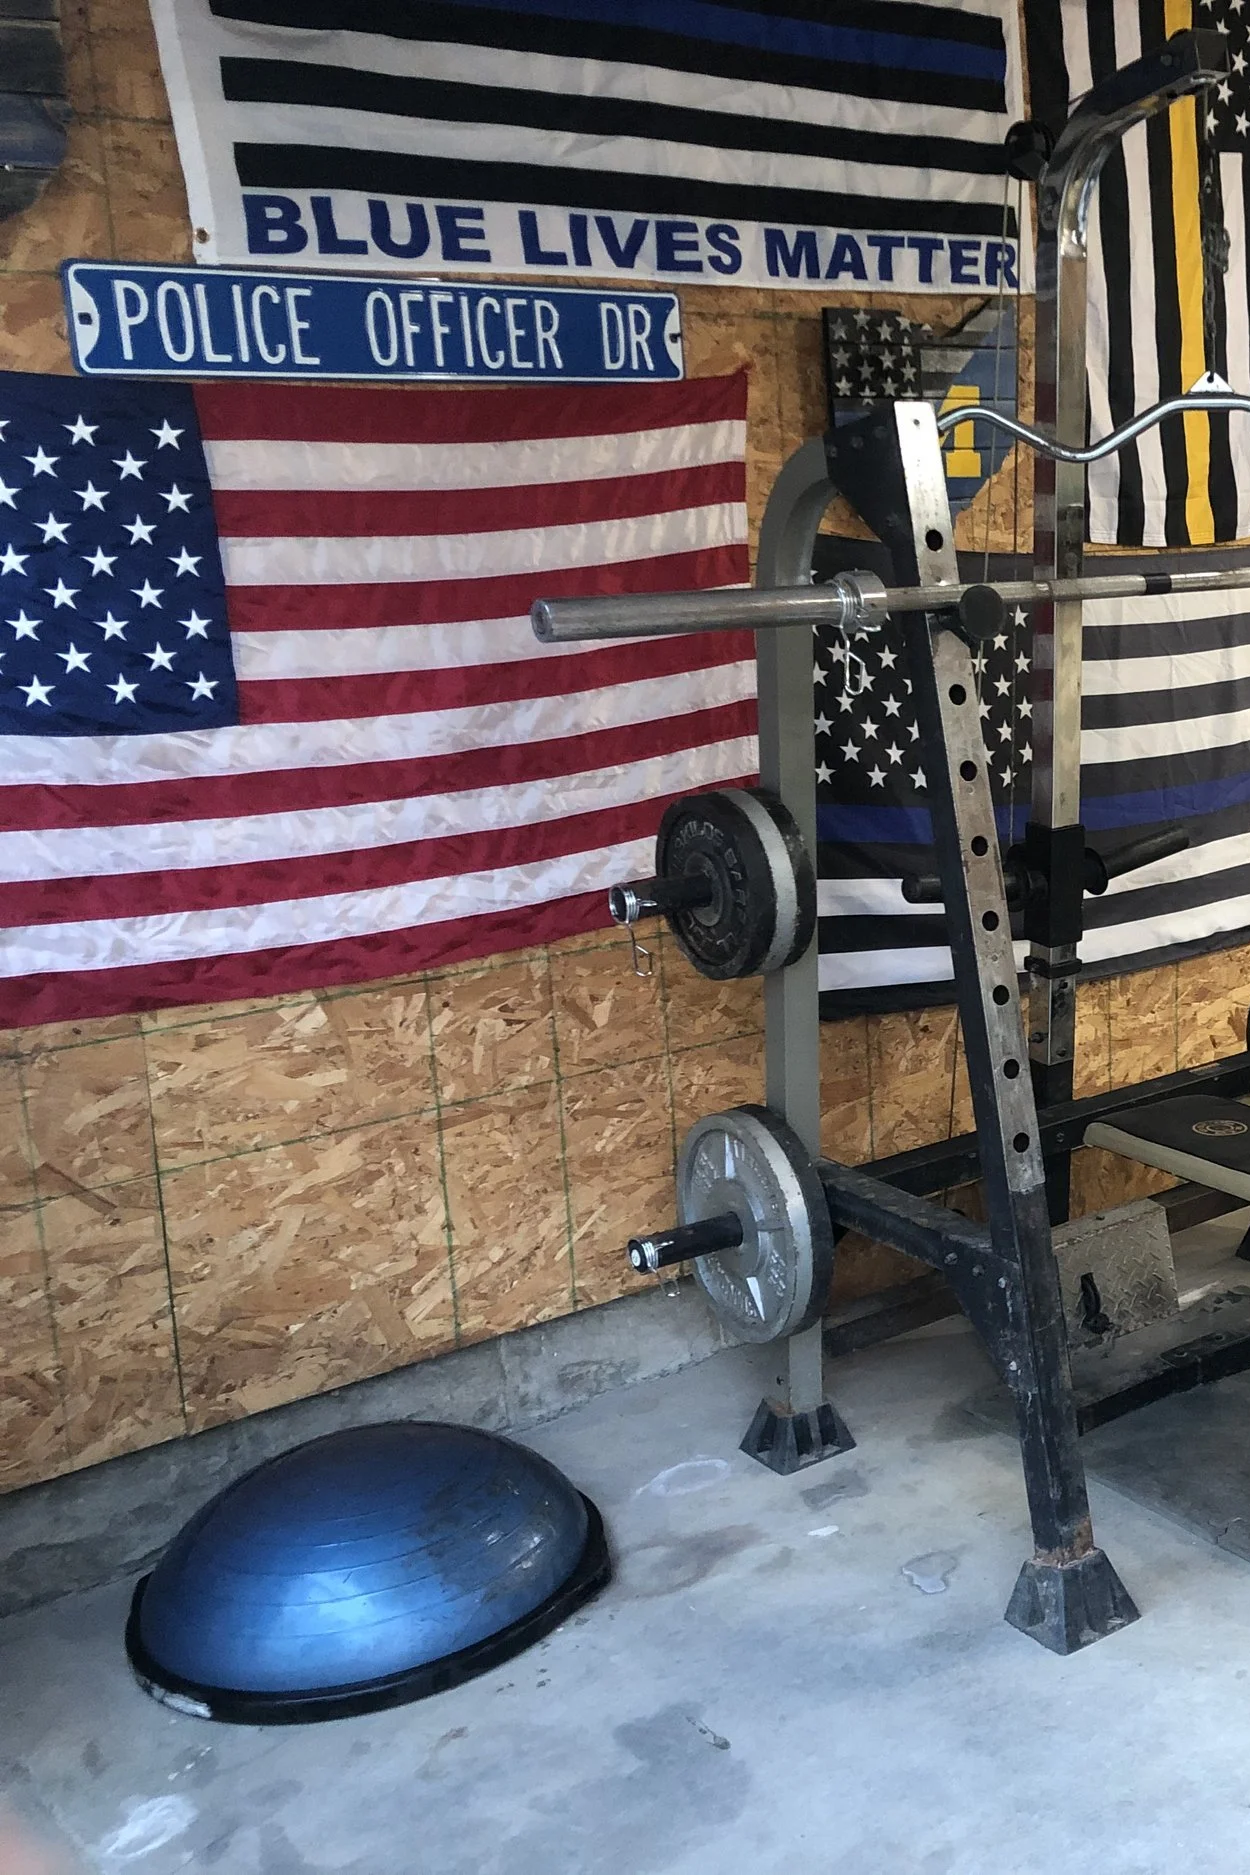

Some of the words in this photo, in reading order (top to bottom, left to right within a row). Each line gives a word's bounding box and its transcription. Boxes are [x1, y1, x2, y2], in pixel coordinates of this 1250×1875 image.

[241, 193, 492, 263] BLUE
[518, 209, 743, 275] LIVES
[763, 227, 1018, 289] MATTER
[112, 278, 321, 366] POLICE
[365, 289, 563, 370] OFFICER
[601, 302, 655, 372] DR
